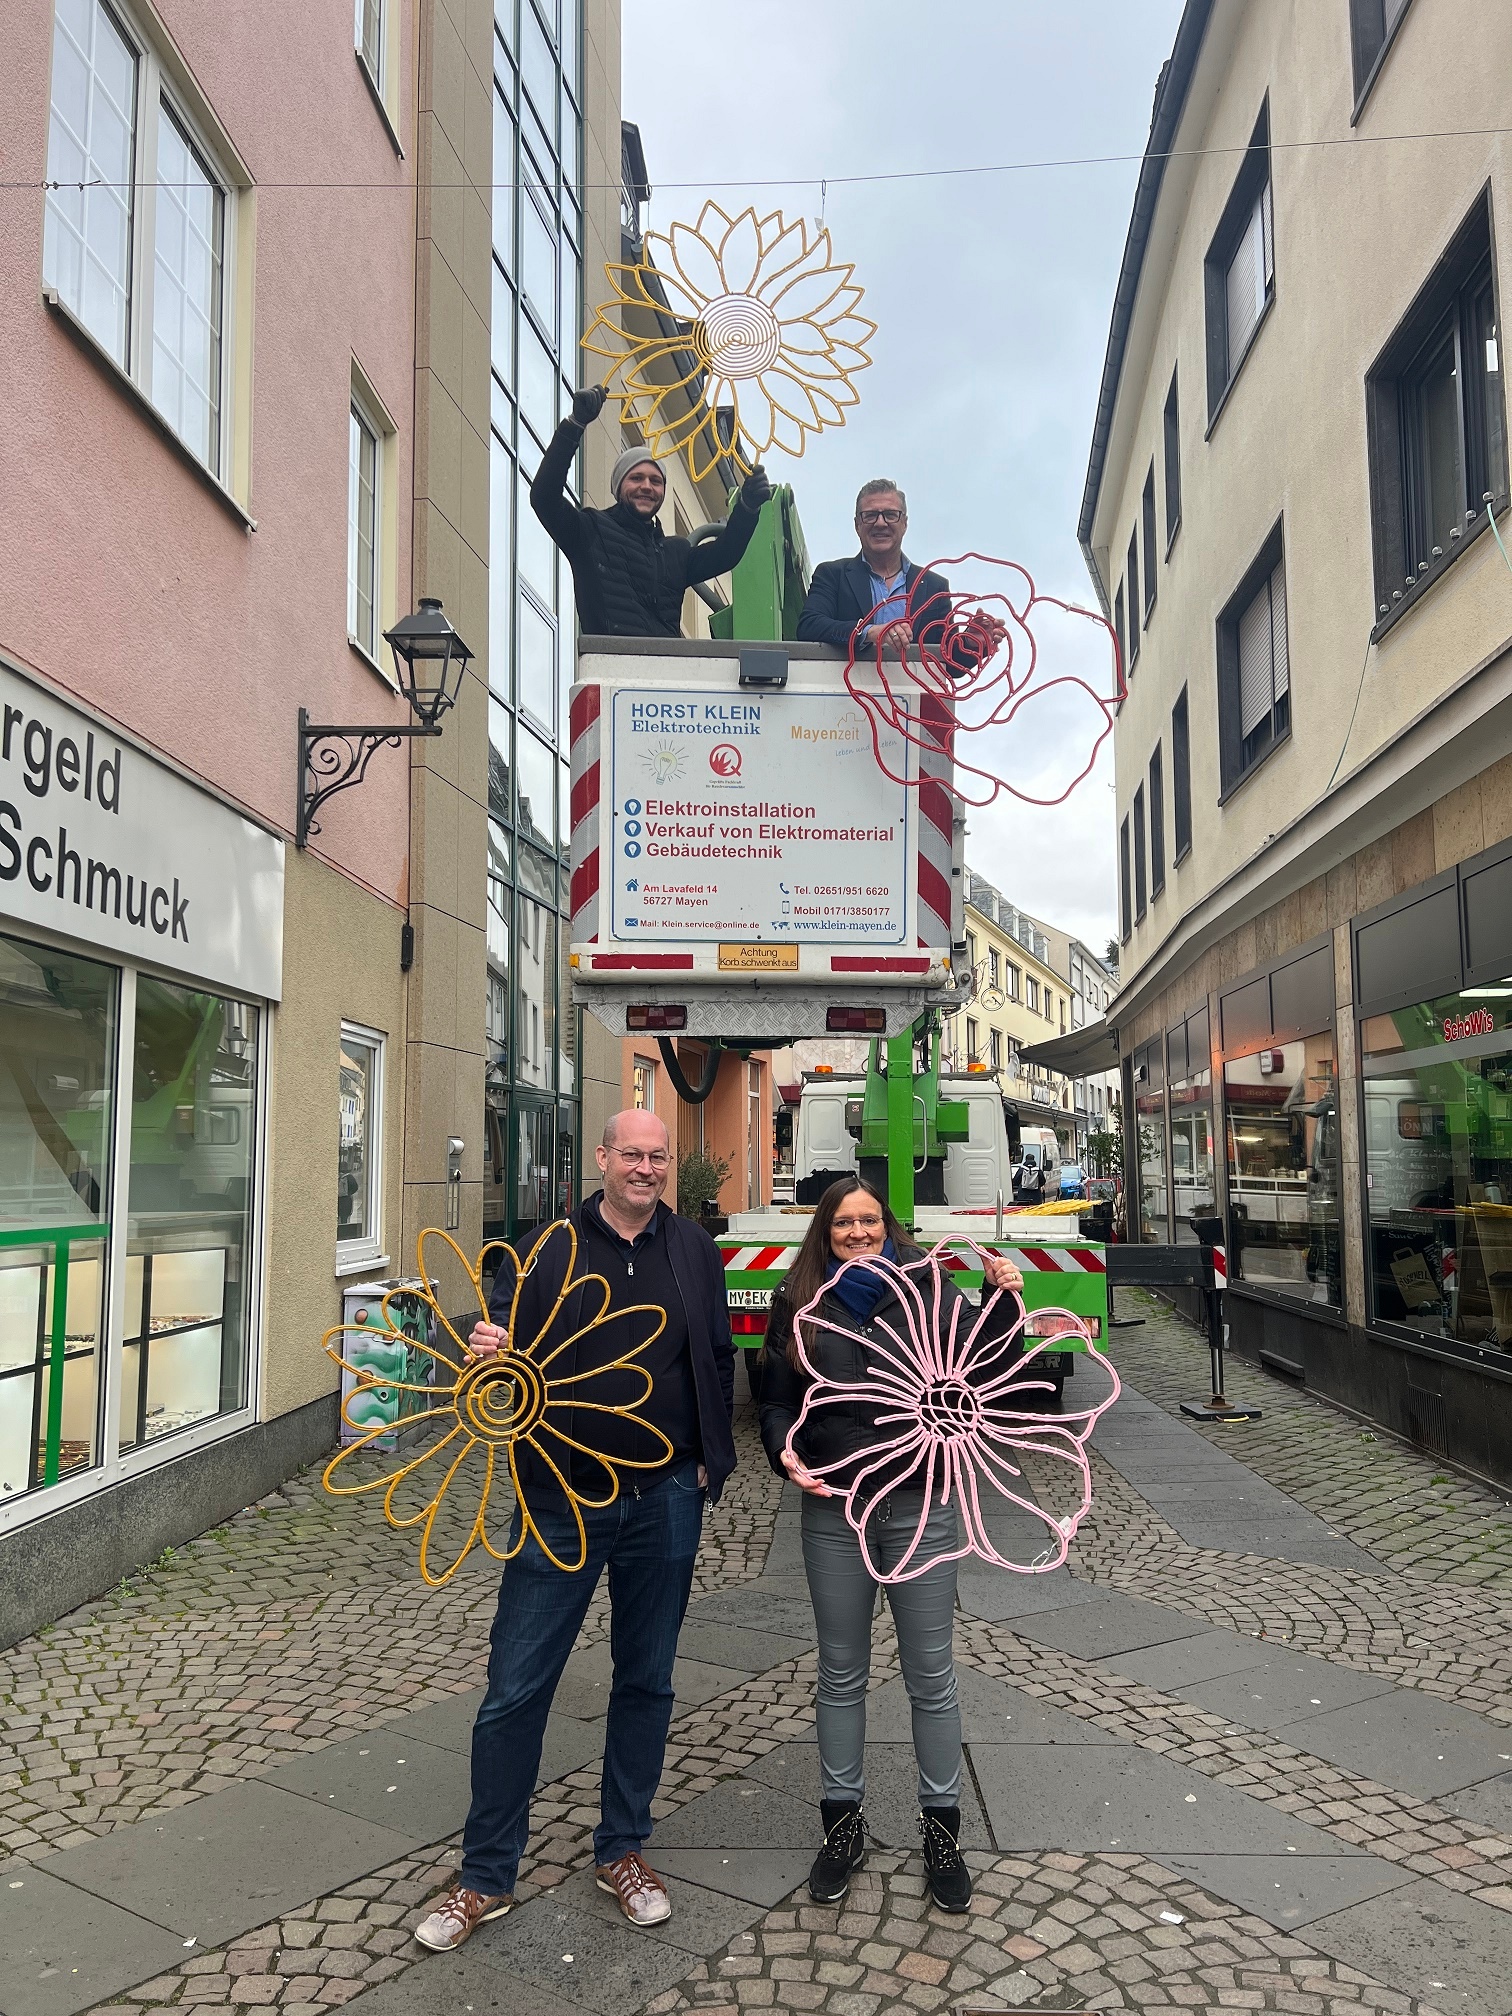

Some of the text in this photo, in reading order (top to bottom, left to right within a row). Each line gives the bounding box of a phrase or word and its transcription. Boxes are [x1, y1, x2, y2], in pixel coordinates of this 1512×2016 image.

[631, 703, 761, 720] HORST KLEIN
[631, 719, 761, 735] Elektrotechnik
[791, 725, 860, 743] Mayenzeit
[2, 703, 122, 815] rgeld
[646, 800, 816, 818] Elektroinstallation
[645, 822, 894, 842] Verkauf von Elektromaterial
[646, 842, 783, 859] Gebäudetechnik
[0, 799, 190, 944] Schmuck
[643, 884, 718, 894] Am Lavafeld 14
[794, 886, 889, 896] Tel. 02651/951 6620
[643, 896, 708, 908] 56727 Mayen
[793, 906, 890, 916] Mobil 0171/3850177
[640, 920, 760, 930] Mail: Klein.service@online.de
[794, 920, 897, 932] www.klein-mayen.de
[740, 947, 778, 959] Achtung
[720, 957, 797, 967] Korb schwenkt aus
[729, 1291, 768, 1305] MY EK
